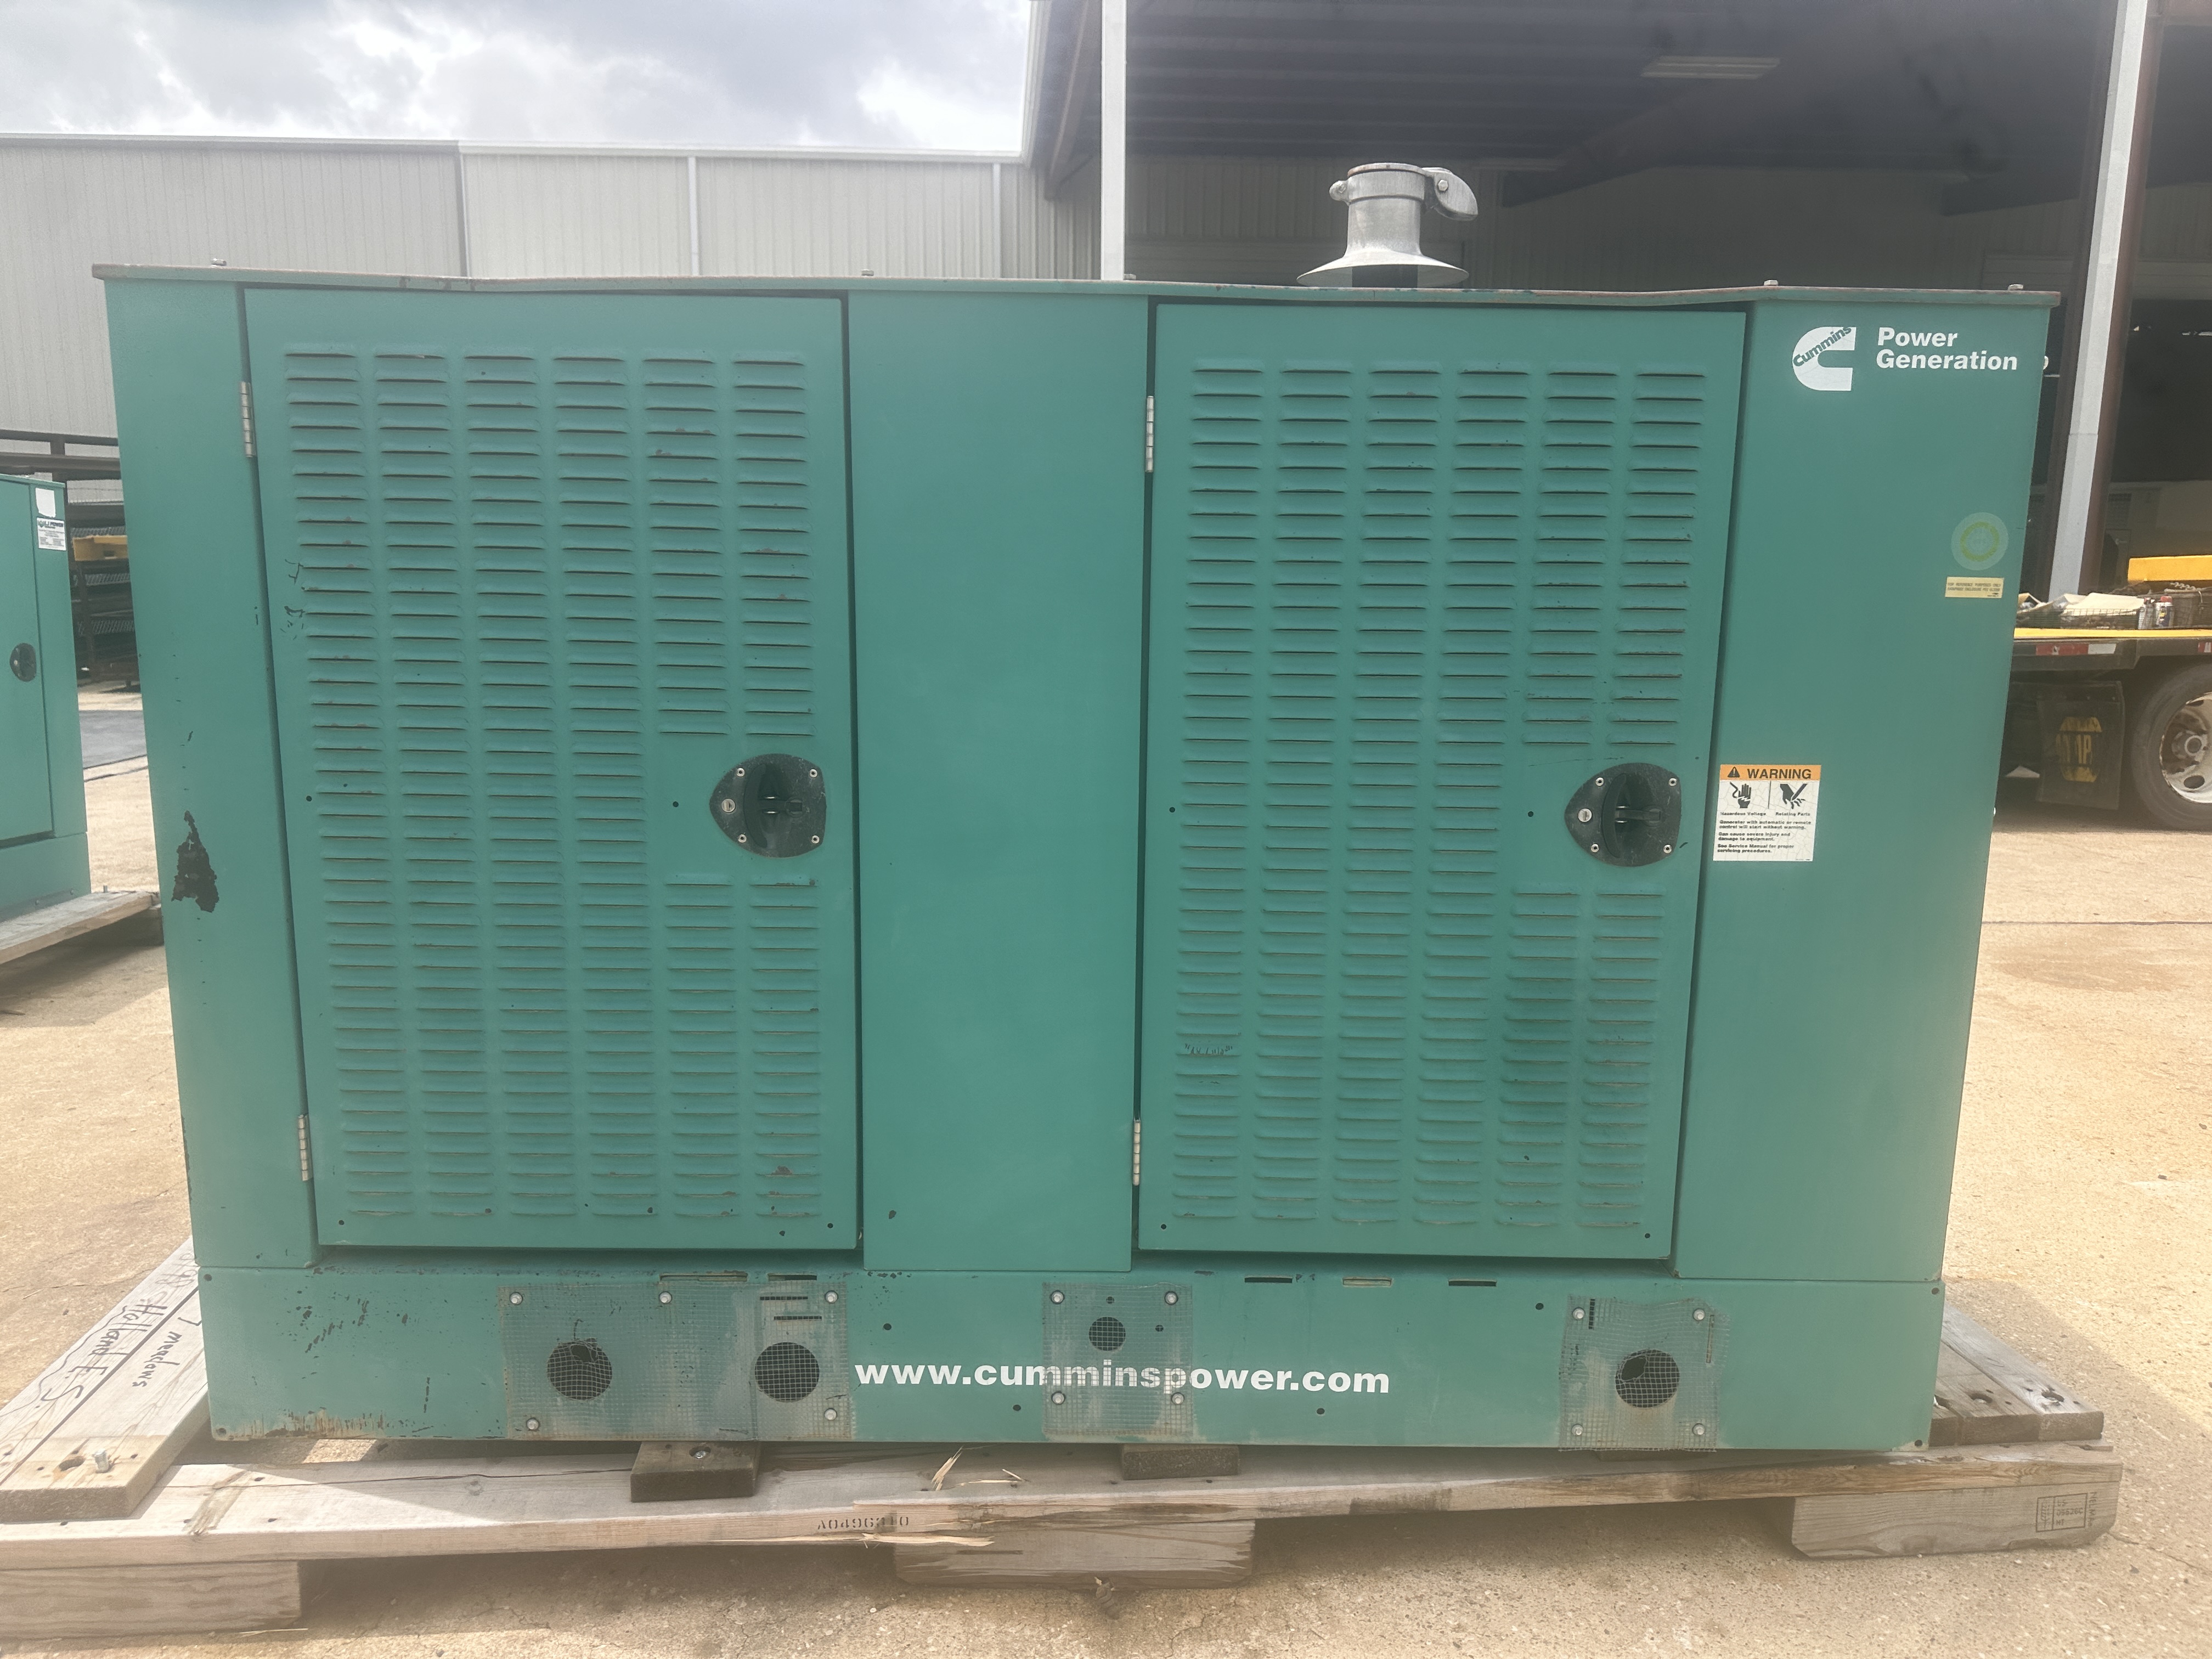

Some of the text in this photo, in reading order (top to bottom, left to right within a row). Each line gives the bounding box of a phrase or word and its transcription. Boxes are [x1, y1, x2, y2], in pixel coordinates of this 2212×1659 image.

[1792, 325, 1852, 367] Cummins
[1877, 327, 1957, 347] Power
[1876, 349, 2017, 370] Generation
[1747, 769, 1812, 779] WARNING
[89, 1304, 167, 1356] Holland
[855, 1359, 1390, 1393] www.cumminspower.com
